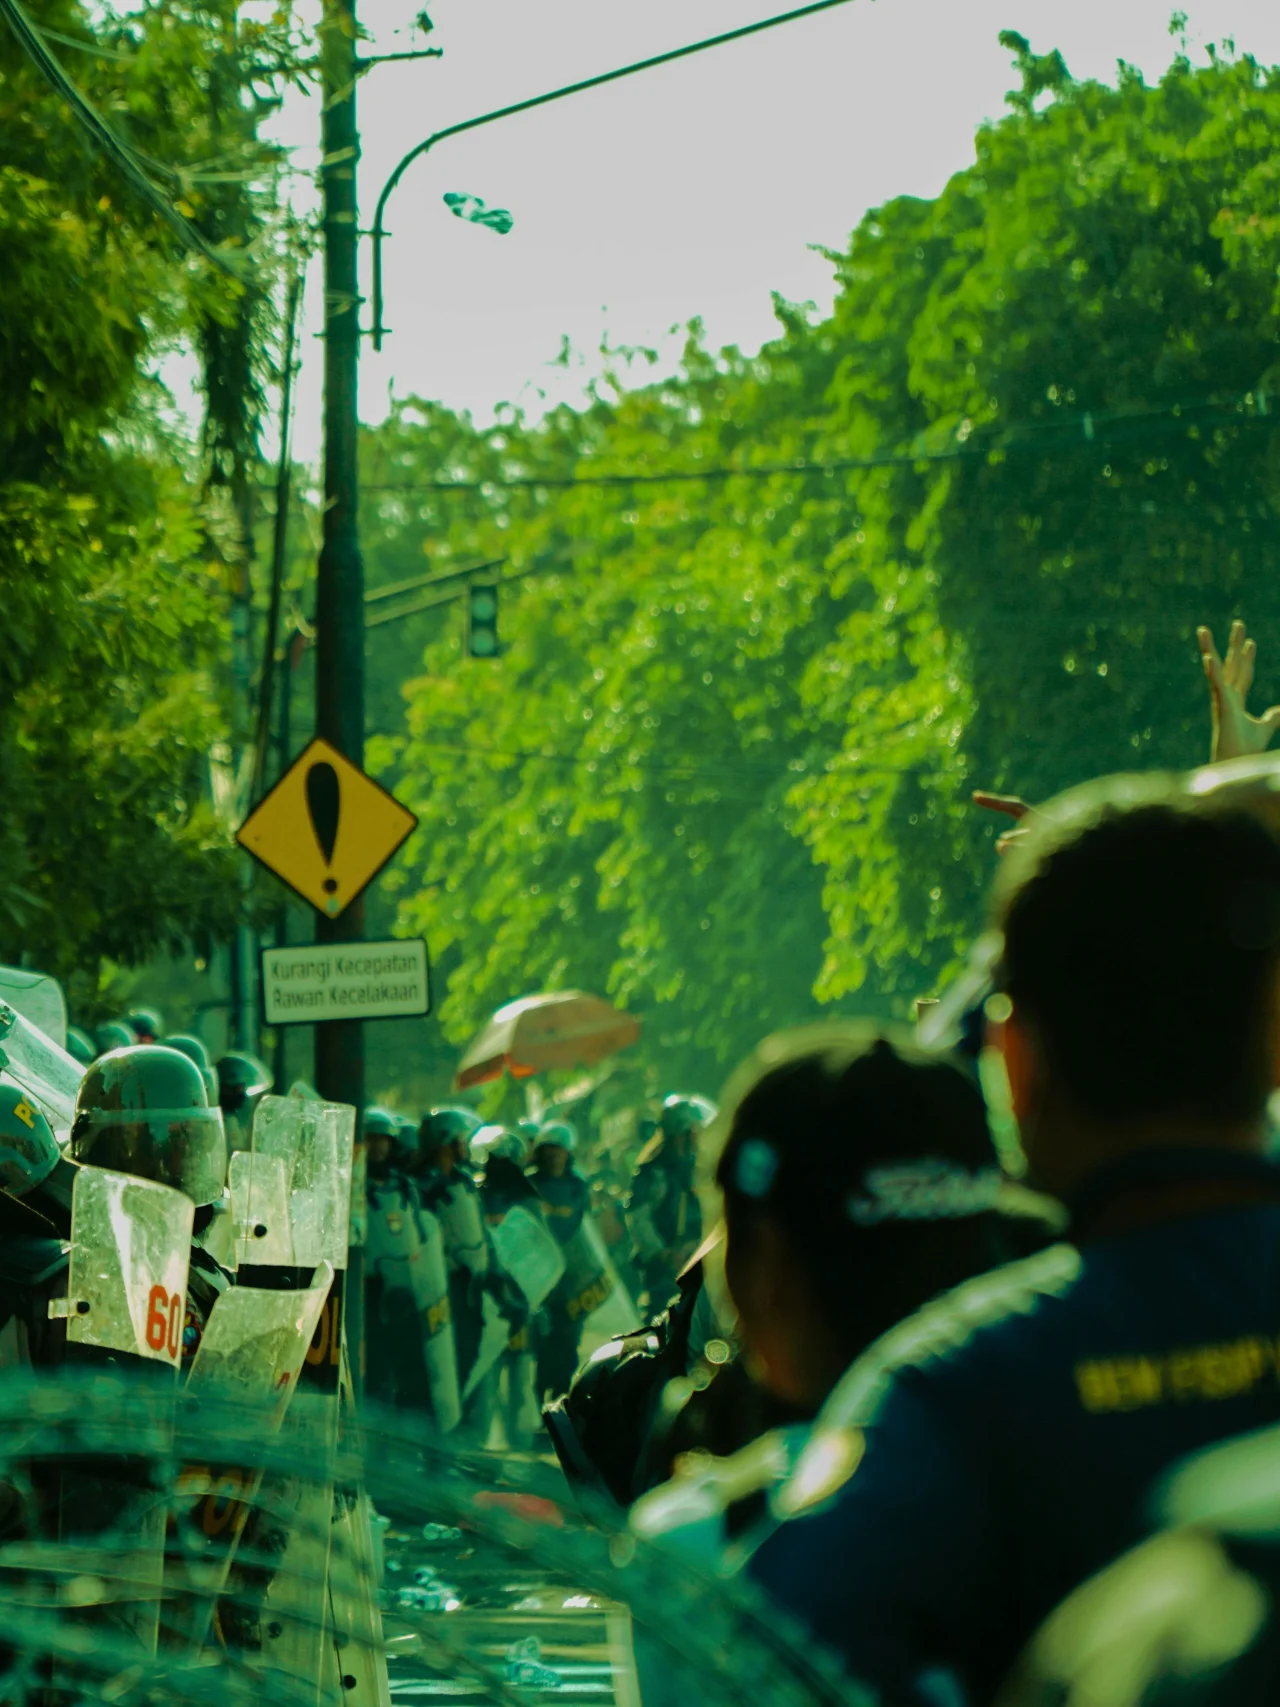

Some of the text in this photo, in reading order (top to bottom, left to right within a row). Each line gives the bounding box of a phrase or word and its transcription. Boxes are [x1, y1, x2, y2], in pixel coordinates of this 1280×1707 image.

[272, 953, 417, 982] Kurangi Kecepatan
[273, 981, 418, 1009] Rawan Kecelakaan
[145, 1284, 181, 1359] 60
